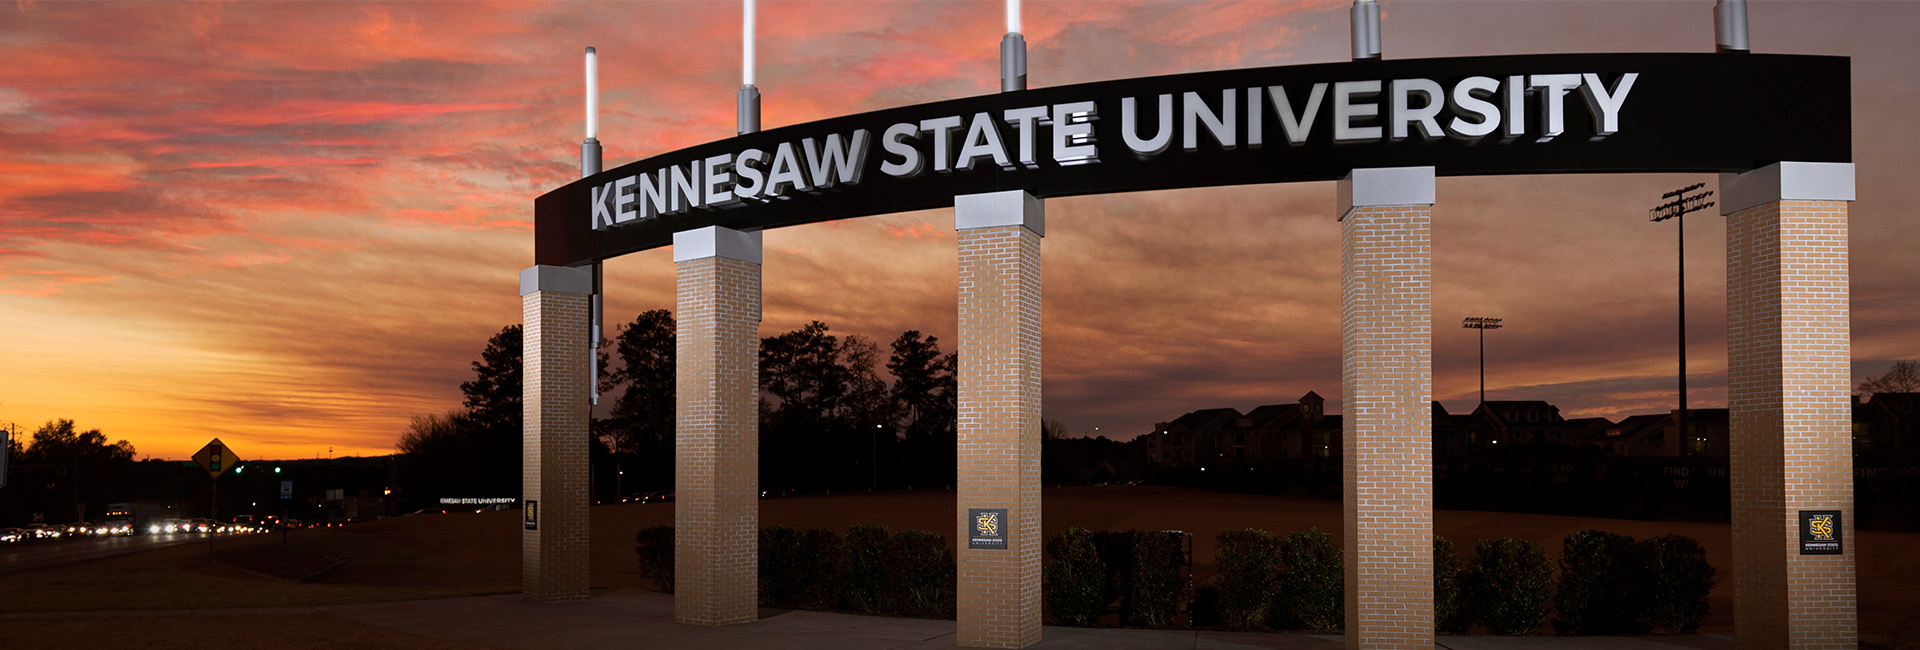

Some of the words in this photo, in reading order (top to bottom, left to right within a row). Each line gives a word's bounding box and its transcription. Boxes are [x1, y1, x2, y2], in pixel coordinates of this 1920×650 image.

[591, 128, 870, 231] KENNESAW
[880, 101, 1097, 173] STATE
[1121, 72, 1640, 154] UNIVERSITY
